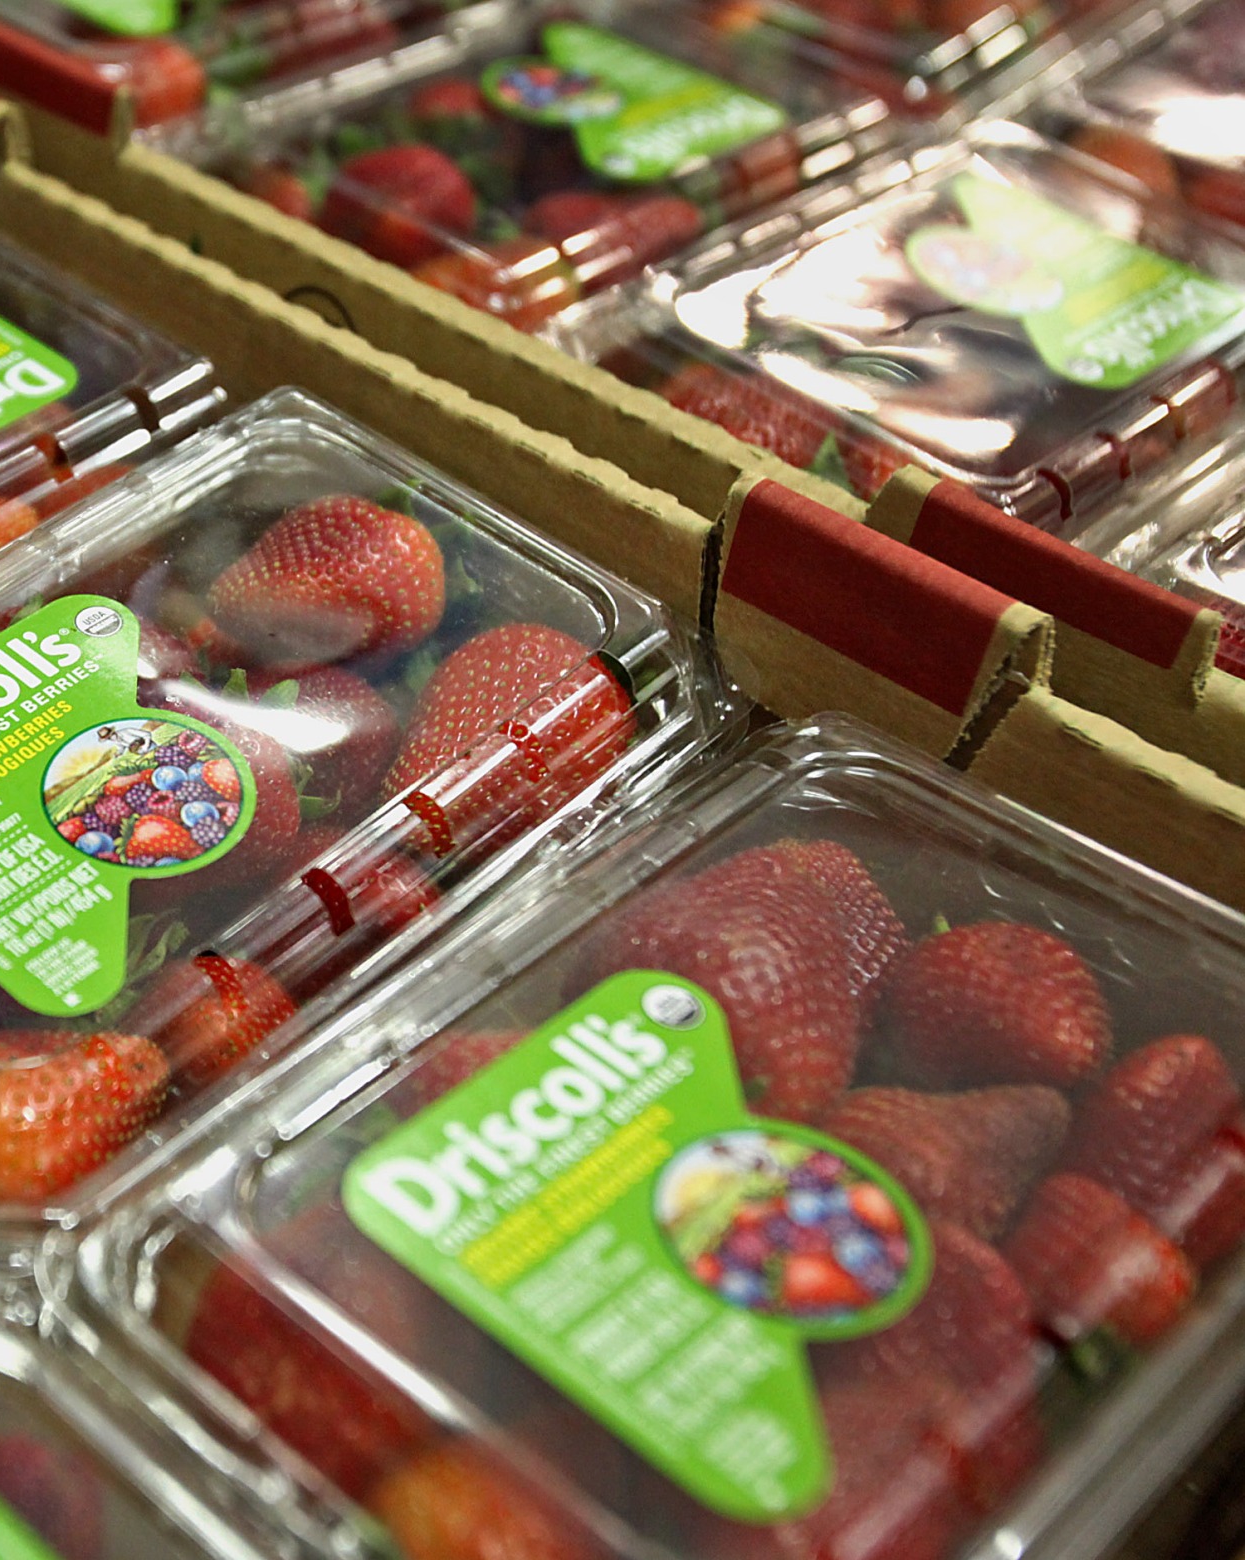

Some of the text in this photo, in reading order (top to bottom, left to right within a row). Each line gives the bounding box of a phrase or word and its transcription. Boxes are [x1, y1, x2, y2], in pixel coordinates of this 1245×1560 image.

[20, 657, 102, 713] BERRIES
[11, 833, 45, 857] USA
[9, 862, 40, 886] DES
[68, 861, 99, 887] NET
[4, 935, 29, 957] 16
[362, 1016, 667, 1236] Driscoll's
